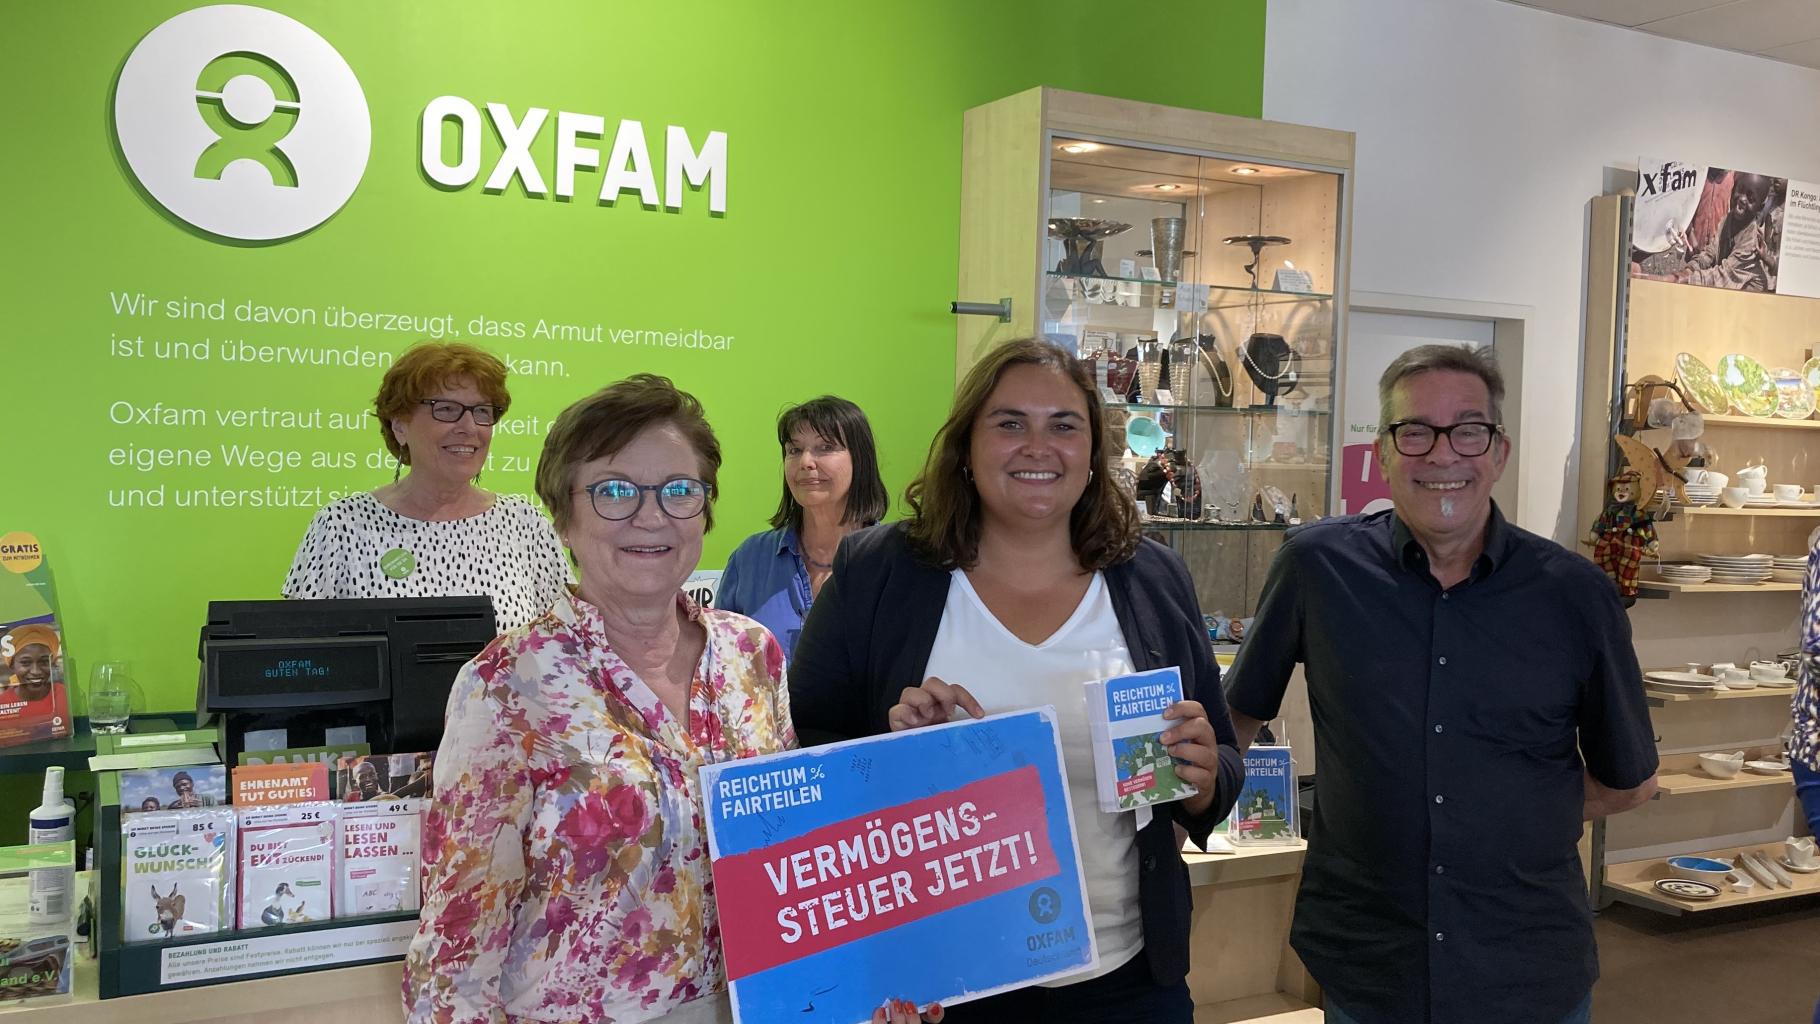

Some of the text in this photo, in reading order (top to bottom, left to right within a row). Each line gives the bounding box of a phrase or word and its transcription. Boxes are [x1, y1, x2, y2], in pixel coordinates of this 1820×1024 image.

[420, 95, 728, 214] OXFAM
[1637, 162, 1697, 197] xfam
[110, 292, 735, 351] Wir sind davon überzeugt, dass Armut vermeidbar
[110, 334, 144, 358] ist
[155, 338, 210, 360] und
[222, 339, 392, 368] überwunden
[505, 354, 570, 377] kann.
[110, 401, 206, 426] Oxfam
[216, 407, 323, 429] vertraut
[329, 408, 371, 430] auf
[1350, 424, 1377, 433] Nur für
[109, 443, 212, 472] eigene
[221, 445, 302, 472] Wege
[311, 451, 357, 469] aus
[502, 456, 530, 472] zu
[109, 485, 164, 507] und
[175, 485, 323, 507] unterstützt
[1, 544, 39, 553] GRATIS
[278, 660, 311, 668] OXFAM
[265, 667, 329, 678] GUTEN TAG!
[1113, 684, 1164, 703] REICHTUM
[1114, 696, 1173, 717] FAIRTEILEN
[1242, 758, 1277, 767] EICHTUM
[240, 777, 308, 790] EHRENAMT
[720, 766, 807, 799] REICHTUM
[240, 791, 265, 801] TUT
[722, 784, 822, 819] FAIRTEILEN
[389, 804, 400, 812] 49
[301, 812, 312, 820] 25
[192, 822, 213, 831] 85 €
[344, 822, 396, 832] LESEN UND
[344, 832, 388, 845] LESEN
[134, 843, 199, 858] GLÜCK-
[344, 845, 398, 859] LASSEN
[763, 801, 998, 896] VERMÖGENS-
[777, 831, 1038, 944] STEUER JETZT!
[1027, 926, 1075, 951] OXFAM
[168, 949, 207, 959] BEZAHLUNG
[224, 944, 249, 952] RABATT
